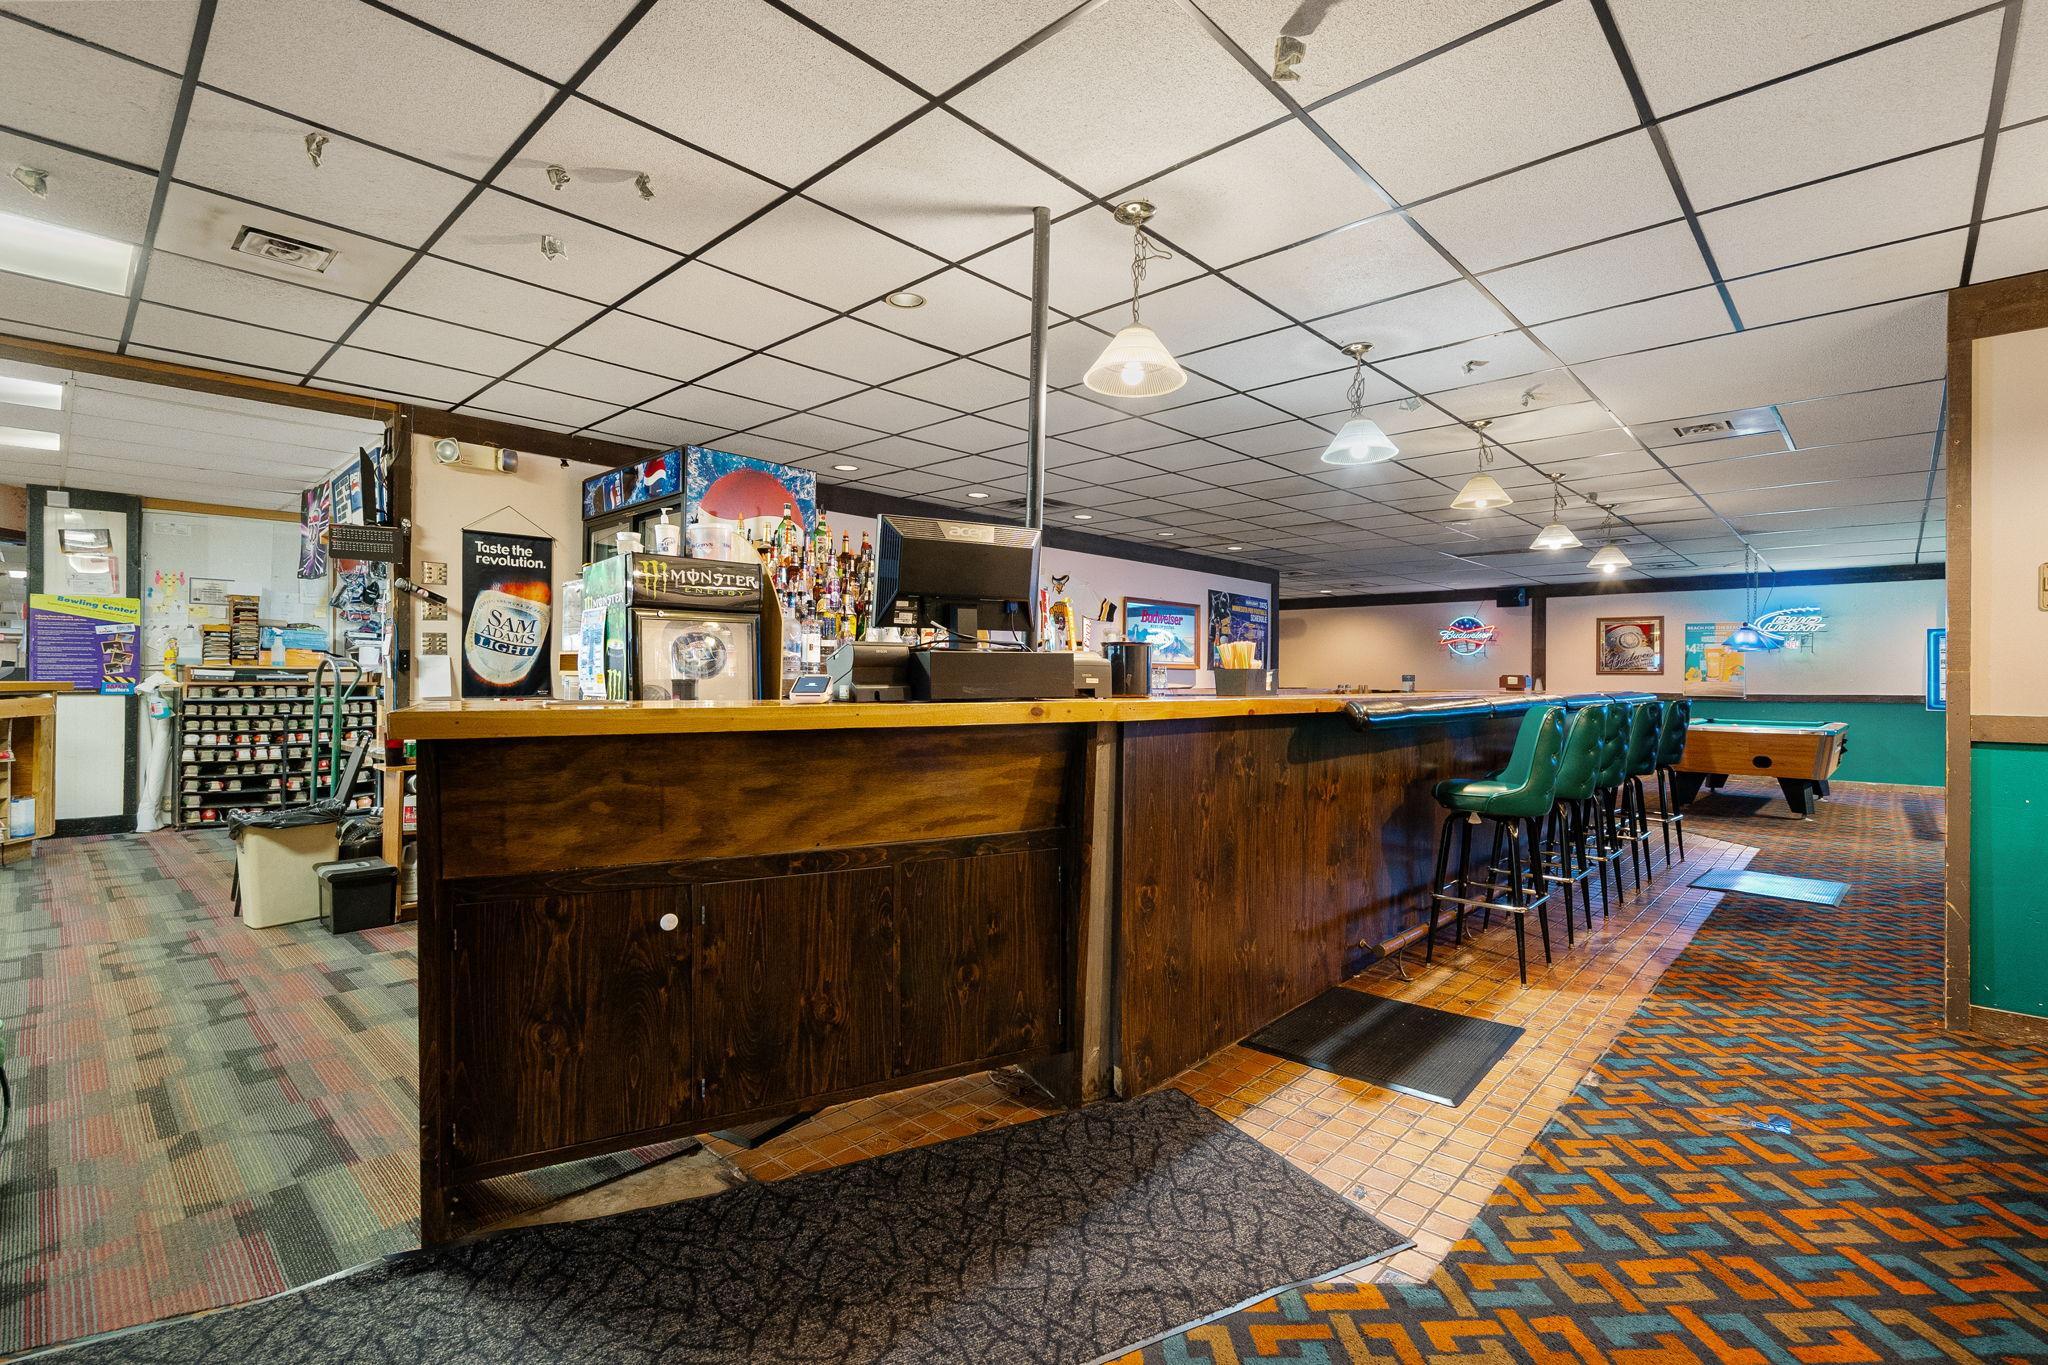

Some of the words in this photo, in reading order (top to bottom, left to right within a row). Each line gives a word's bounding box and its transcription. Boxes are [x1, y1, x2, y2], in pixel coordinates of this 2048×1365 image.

[948, 525, 988, 538] acer
[475, 541, 509, 555] Taste
[512, 545, 533, 557] the
[475, 555, 546, 569] revolution.
[670, 568, 759, 589] MONSTER
[684, 586, 745, 597] ENERGY
[57, 595, 98, 609] Bowling
[102, 602, 138, 615] Center!
[488, 609, 538, 634] SAM
[1141, 609, 1184, 625] Budweiser
[481, 625, 535, 645] ADAMS
[1440, 630, 1492, 640] Budweiser
[478, 637, 533, 656] LIGHT
